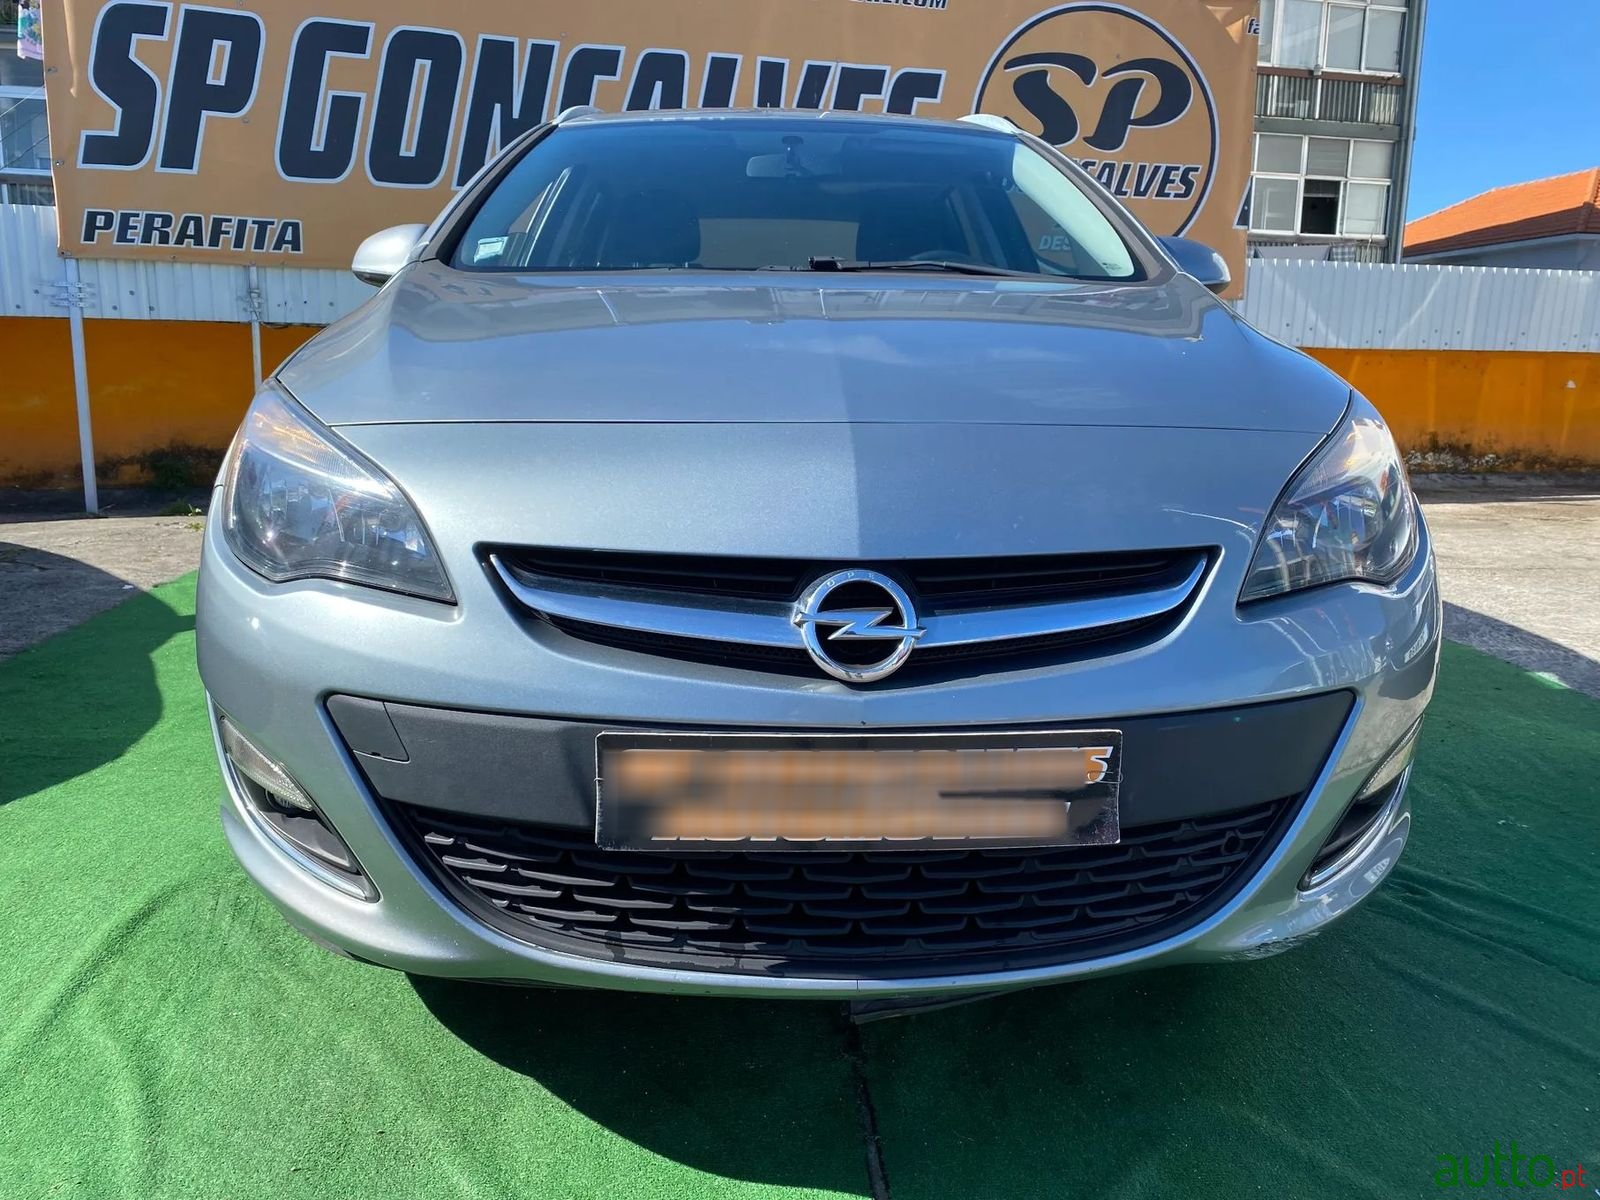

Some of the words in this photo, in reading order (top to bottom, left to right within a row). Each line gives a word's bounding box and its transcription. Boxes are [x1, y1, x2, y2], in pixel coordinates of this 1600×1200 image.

[77, 0, 266, 175] SP
[1003, 52, 1194, 152] SP
[80, 208, 304, 254] PERAFITA
